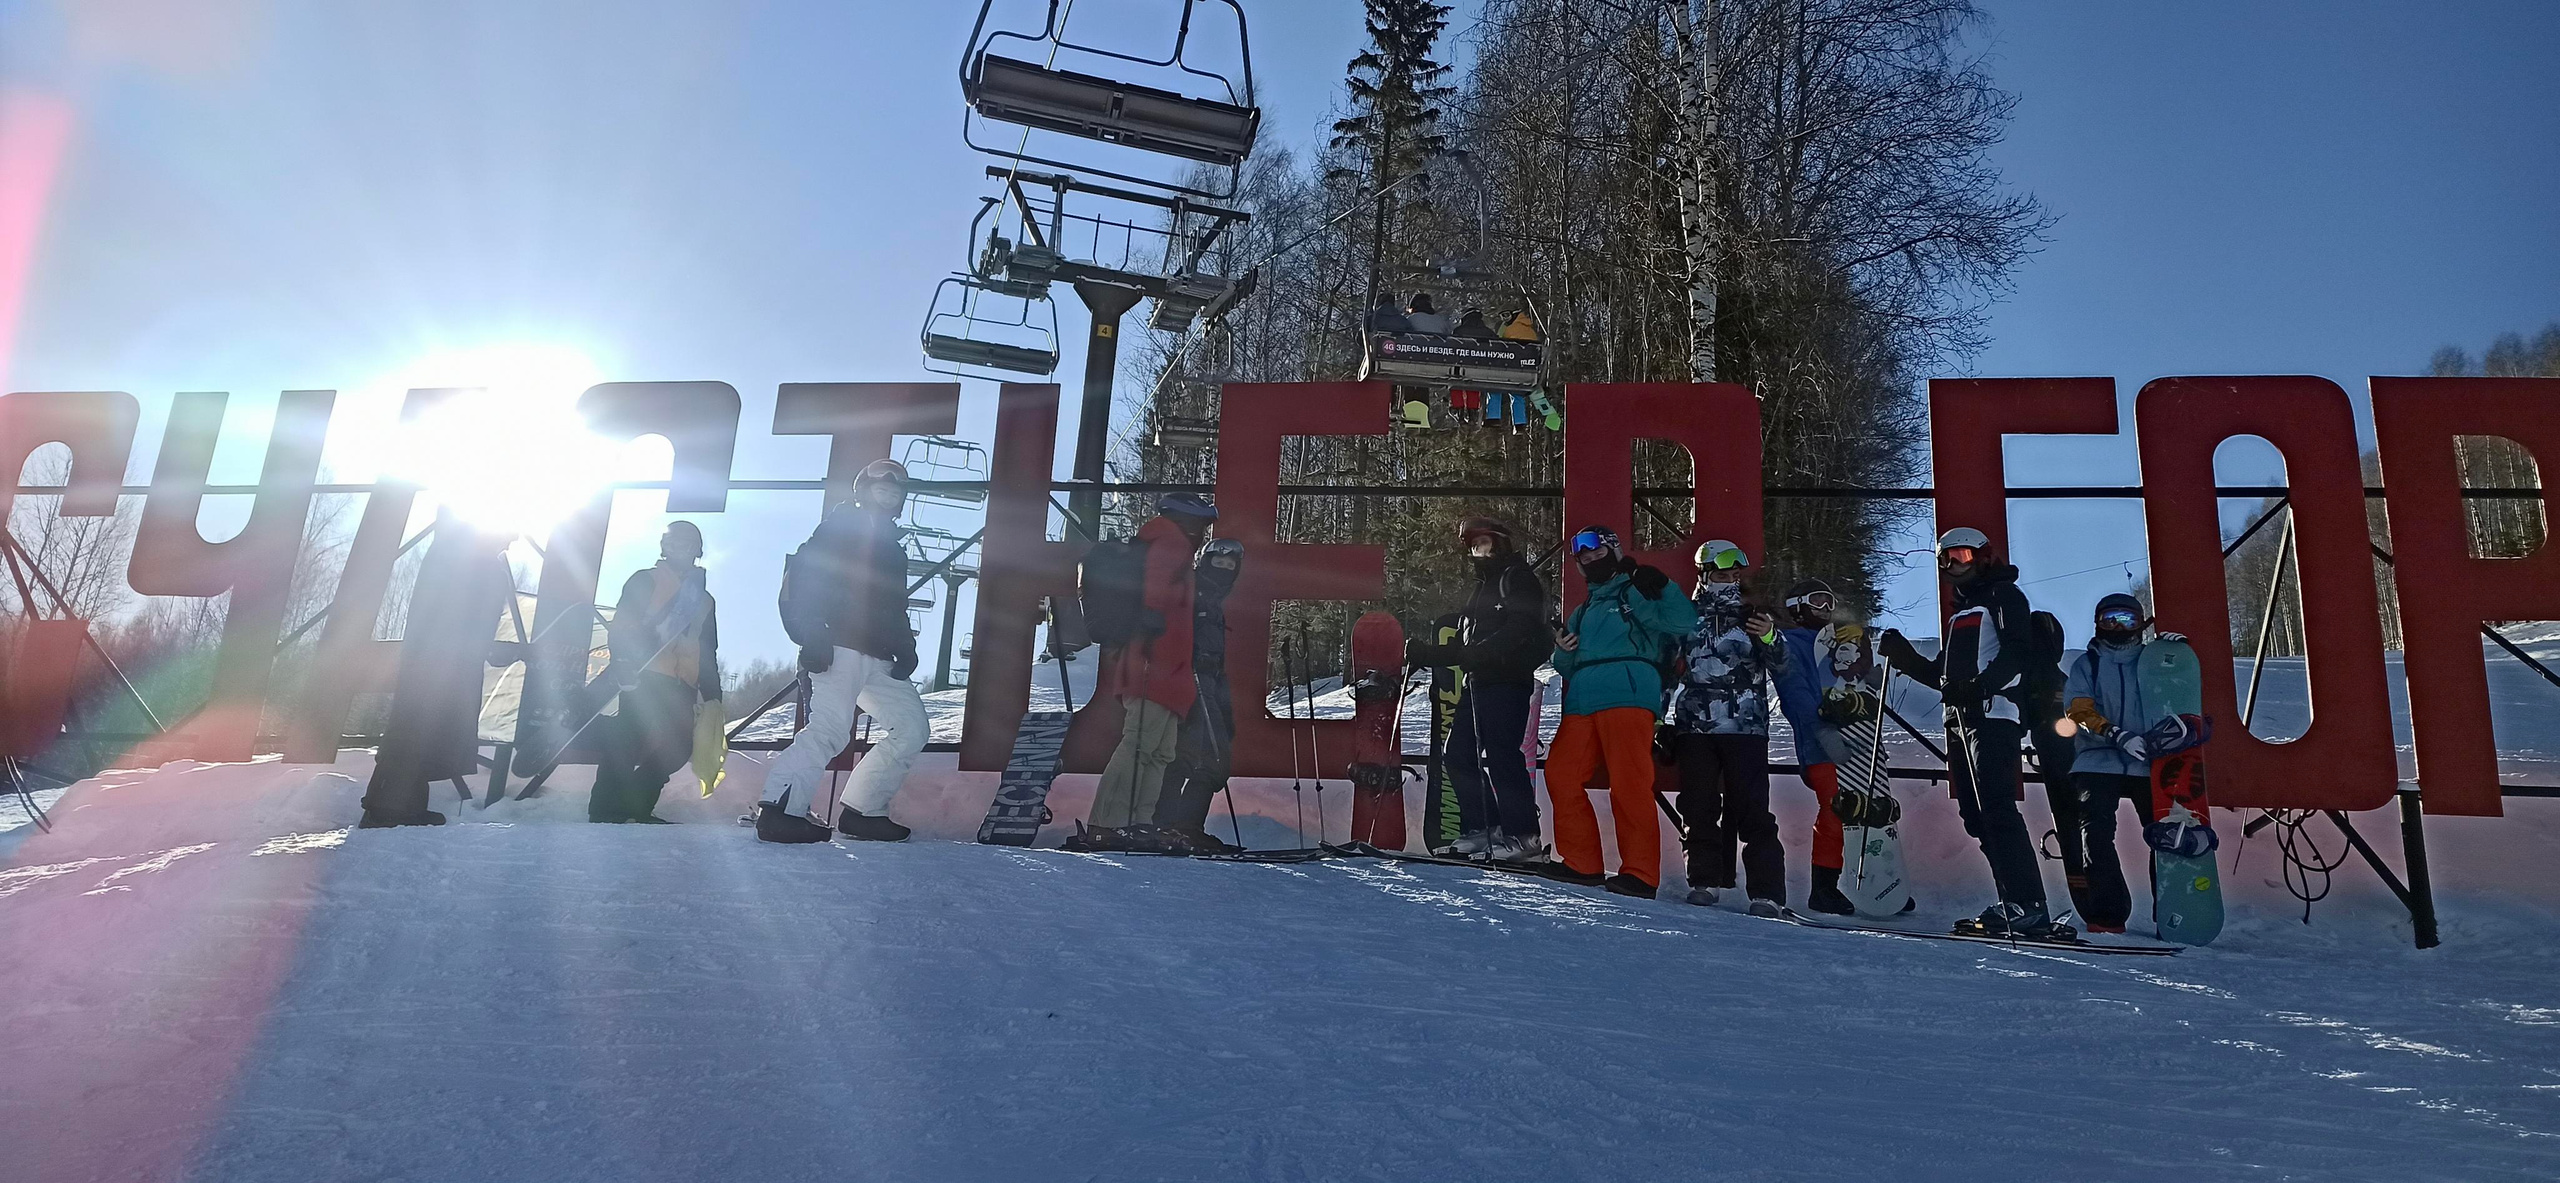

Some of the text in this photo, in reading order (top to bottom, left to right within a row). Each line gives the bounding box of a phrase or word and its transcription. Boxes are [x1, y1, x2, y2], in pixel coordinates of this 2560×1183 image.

[1101, 326, 1108, 335] 4
[1383, 343, 1515, 360] 4G ЗДЕСЬ И ВЕЗДЕ, ГДЕ ВАМ НУЖНО
